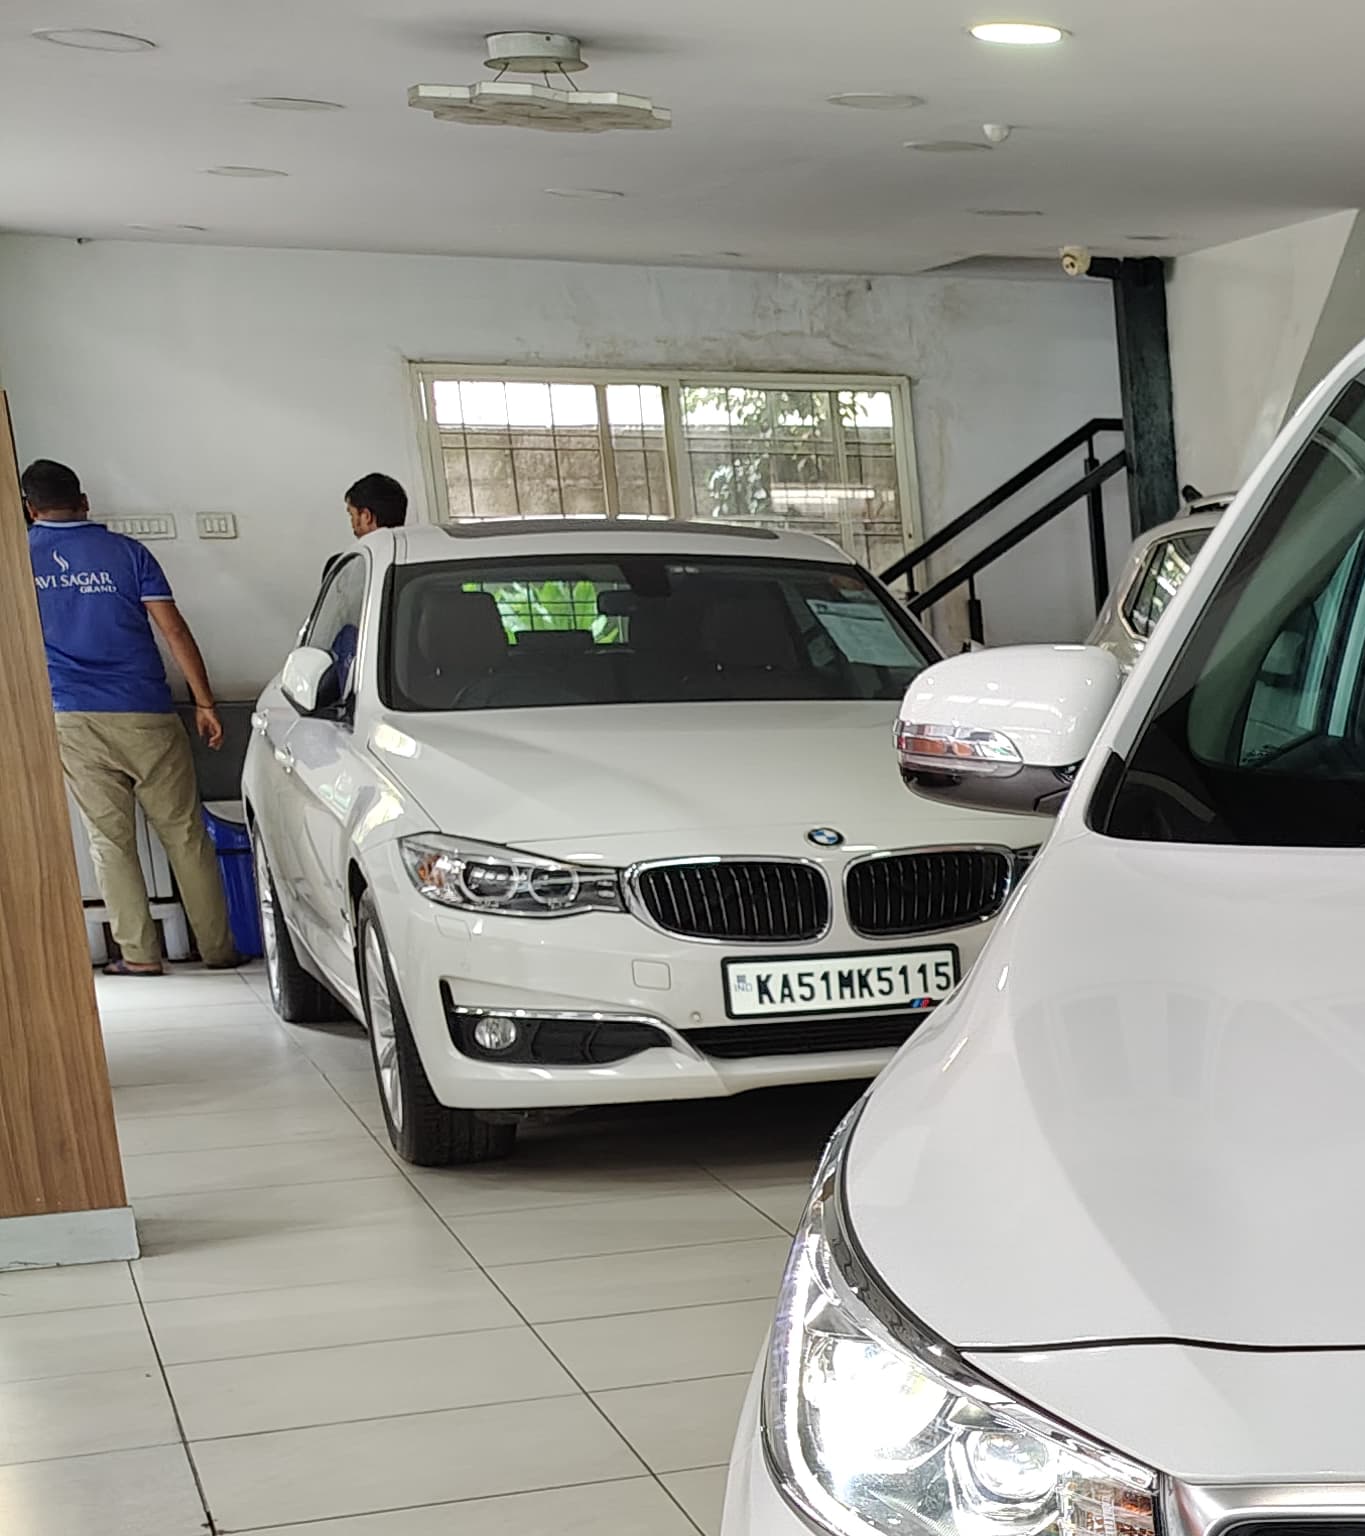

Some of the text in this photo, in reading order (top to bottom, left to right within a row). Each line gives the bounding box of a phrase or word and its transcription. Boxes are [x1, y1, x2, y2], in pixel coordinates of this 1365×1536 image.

[60, 571, 112, 588] SAGAR
[80, 585, 117, 594] GRAND
[756, 961, 950, 1005] KA51MK5115
